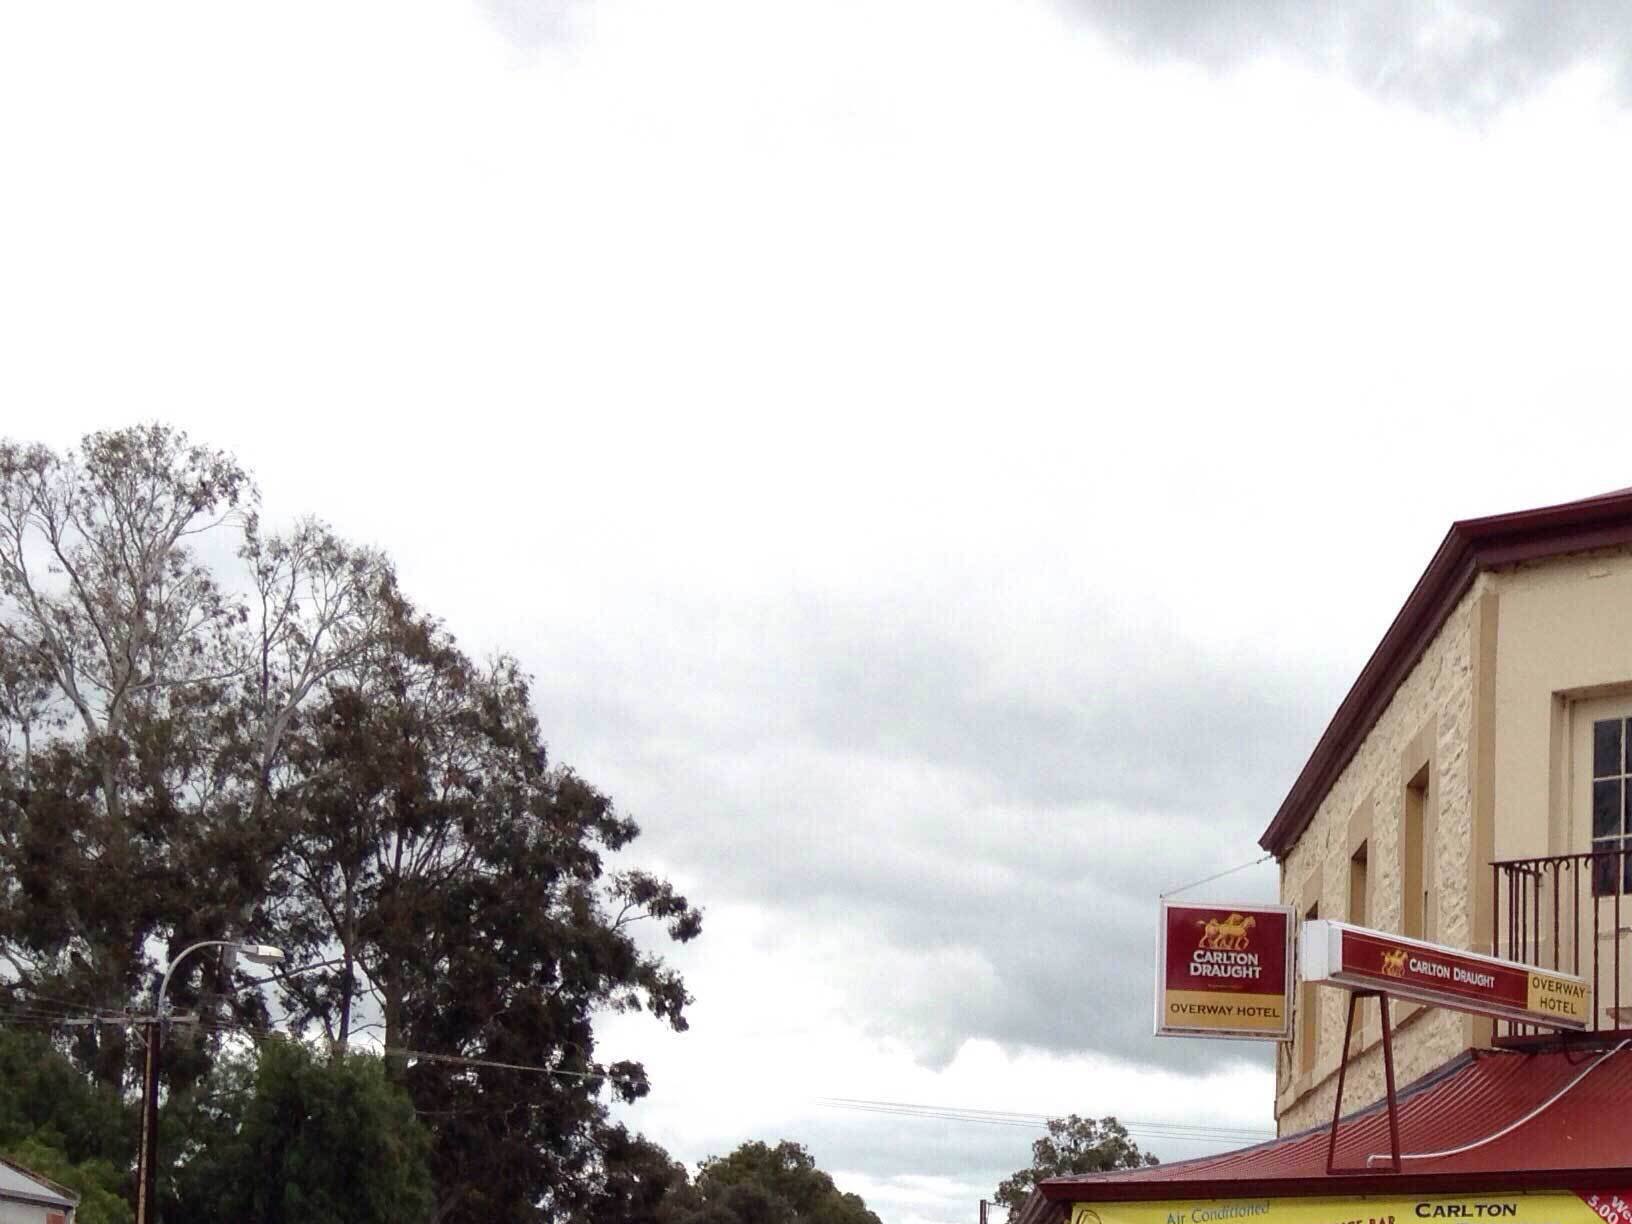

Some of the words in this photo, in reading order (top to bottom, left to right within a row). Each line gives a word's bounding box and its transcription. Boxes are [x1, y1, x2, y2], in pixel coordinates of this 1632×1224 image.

[1193, 950, 1258, 965] CARLTON
[1189, 962, 1262, 979] DRAUGHT
[1409, 958, 1450, 978] CARLTON
[1453, 967, 1495, 989] DRAUGHT
[1532, 977, 1586, 998] OVERWAY
[1170, 1003, 1233, 1016] OVERWAY
[1237, 1006, 1280, 1018] HOTEL
[1540, 997, 1577, 1014] HOTEL
[1192, 1200, 1270, 1223] Conditioned
[1415, 1203, 1517, 1218] CARLTON
